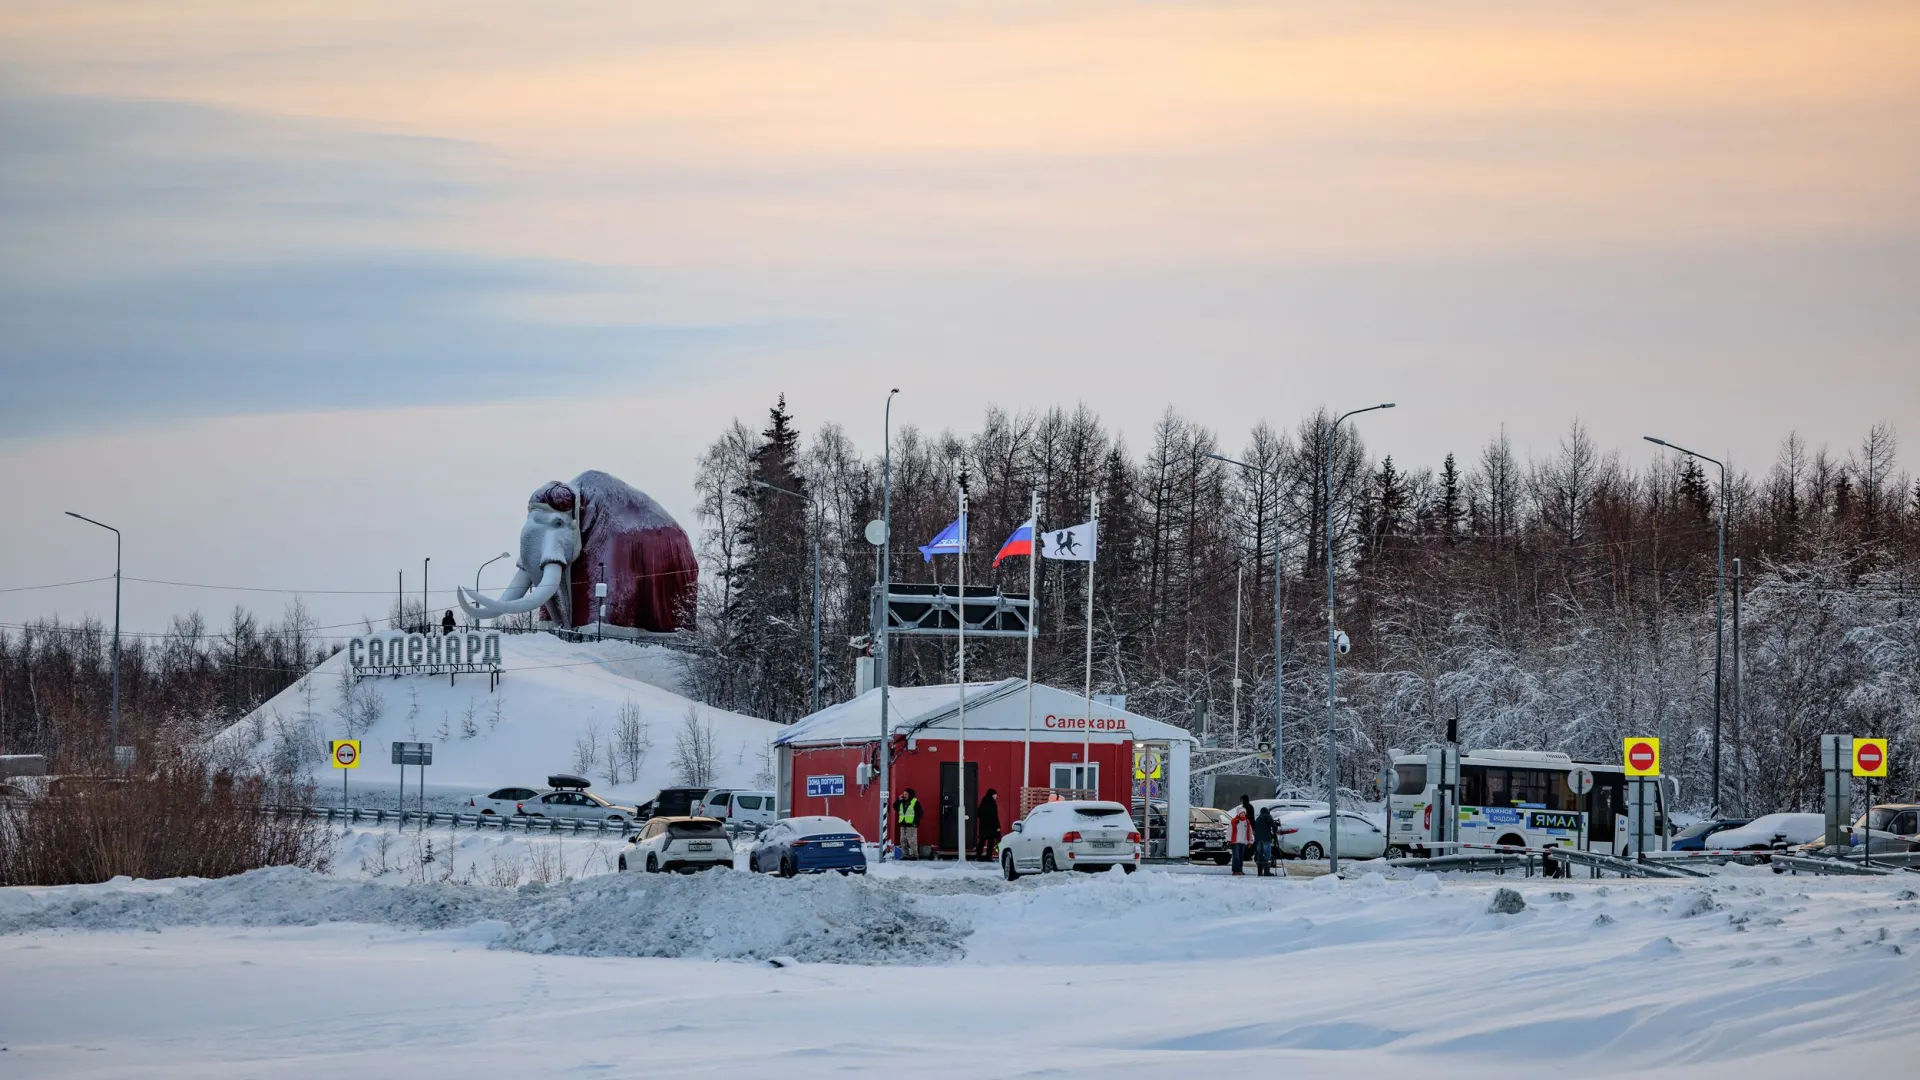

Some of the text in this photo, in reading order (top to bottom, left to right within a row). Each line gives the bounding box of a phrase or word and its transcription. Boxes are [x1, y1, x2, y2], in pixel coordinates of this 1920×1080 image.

[1045, 714, 1126, 730] Салехард
[808, 777, 843, 786] ЗОНА ПОГРУЗКИ
[1493, 815, 1516, 823] РЯДОМ
[1535, 814, 1577, 828] ЯМАЛ
